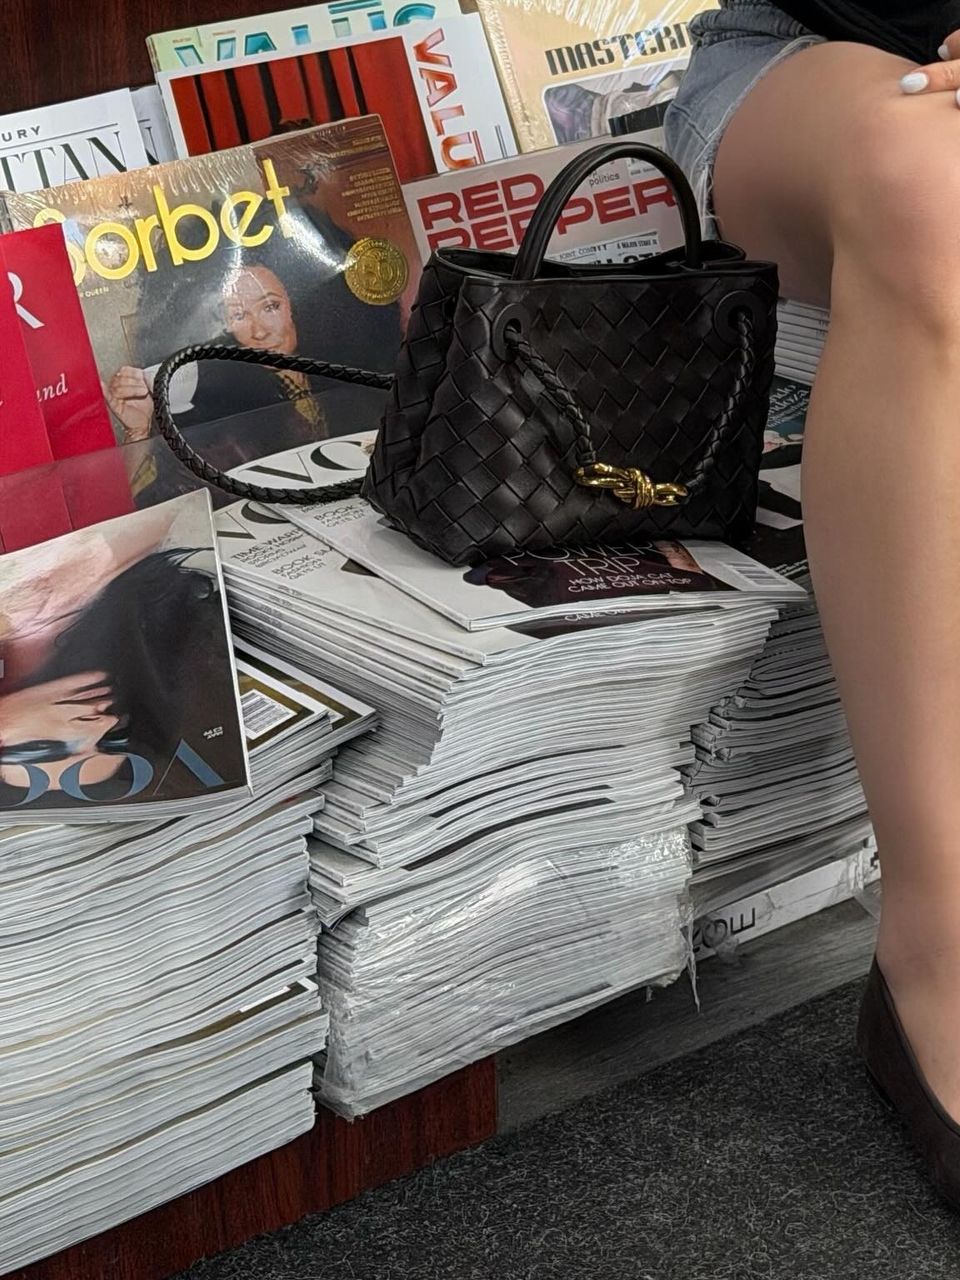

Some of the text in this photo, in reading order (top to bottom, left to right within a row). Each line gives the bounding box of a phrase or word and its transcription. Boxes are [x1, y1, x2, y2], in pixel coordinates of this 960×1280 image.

[589, 172, 621, 187] politics
[417, 172, 545, 231] RED
[314, 503, 353, 521] BOOK
[272, 554, 311, 576] BOOK
[553, 556, 641, 576] TRIP
[569, 572, 675, 586] HOW DOJA CAT
